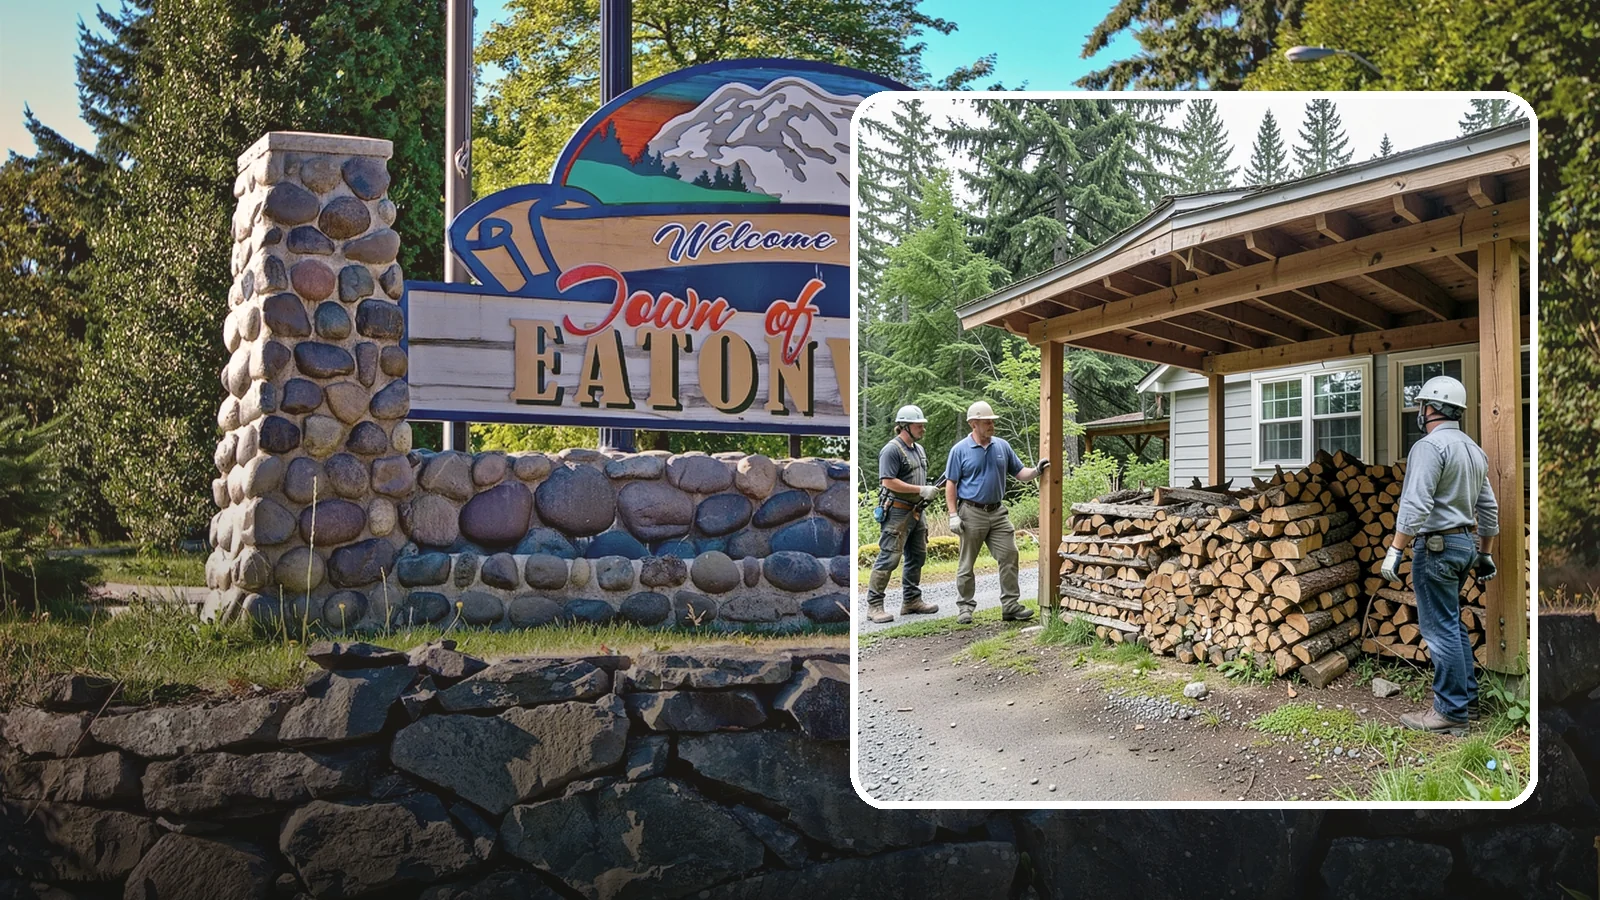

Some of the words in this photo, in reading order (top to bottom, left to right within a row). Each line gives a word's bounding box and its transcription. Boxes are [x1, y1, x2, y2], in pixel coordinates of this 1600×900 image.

[653, 220, 837, 263] Welcome
[556, 263, 738, 337] Town
[764, 278, 826, 365] of
